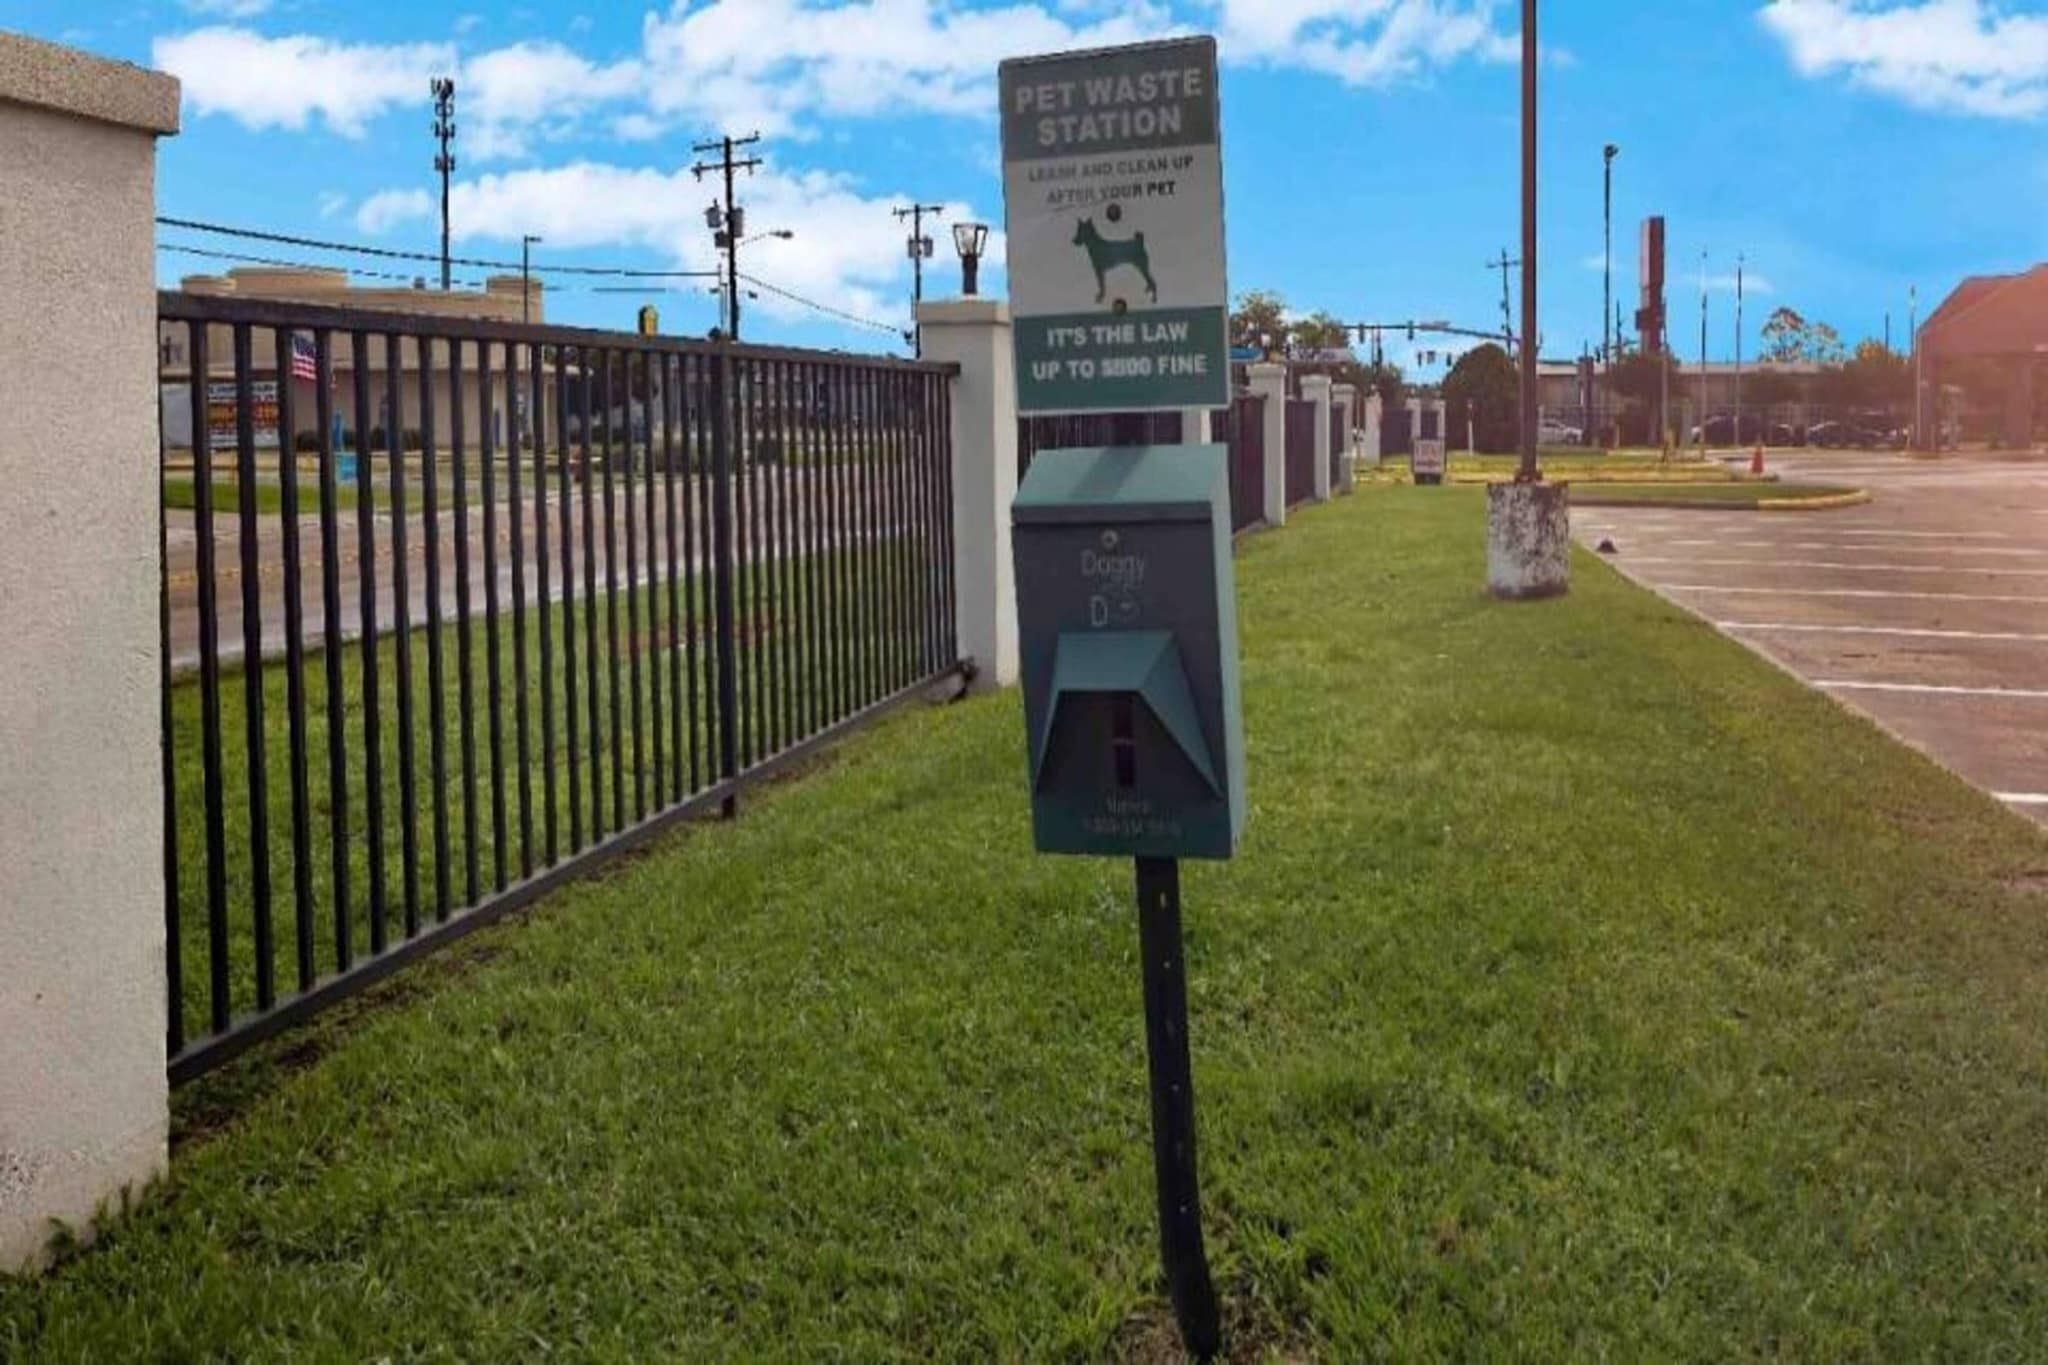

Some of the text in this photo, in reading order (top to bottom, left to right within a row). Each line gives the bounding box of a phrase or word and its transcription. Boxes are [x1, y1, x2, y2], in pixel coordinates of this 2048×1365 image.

[1015, 67, 1203, 114] PET WASTE
[1037, 103, 1182, 147] STATION
[1082, 161, 1113, 177] AND
[1116, 156, 1168, 175] CLEAN
[1172, 154, 1194, 169] UP
[1046, 180, 1176, 204] AFTER YOUR PET
[1047, 321, 1189, 347] IT'S THE LAW
[1032, 360, 1060, 381] UP
[1065, 358, 1095, 379] TO
[1157, 352, 1208, 376] FINE
